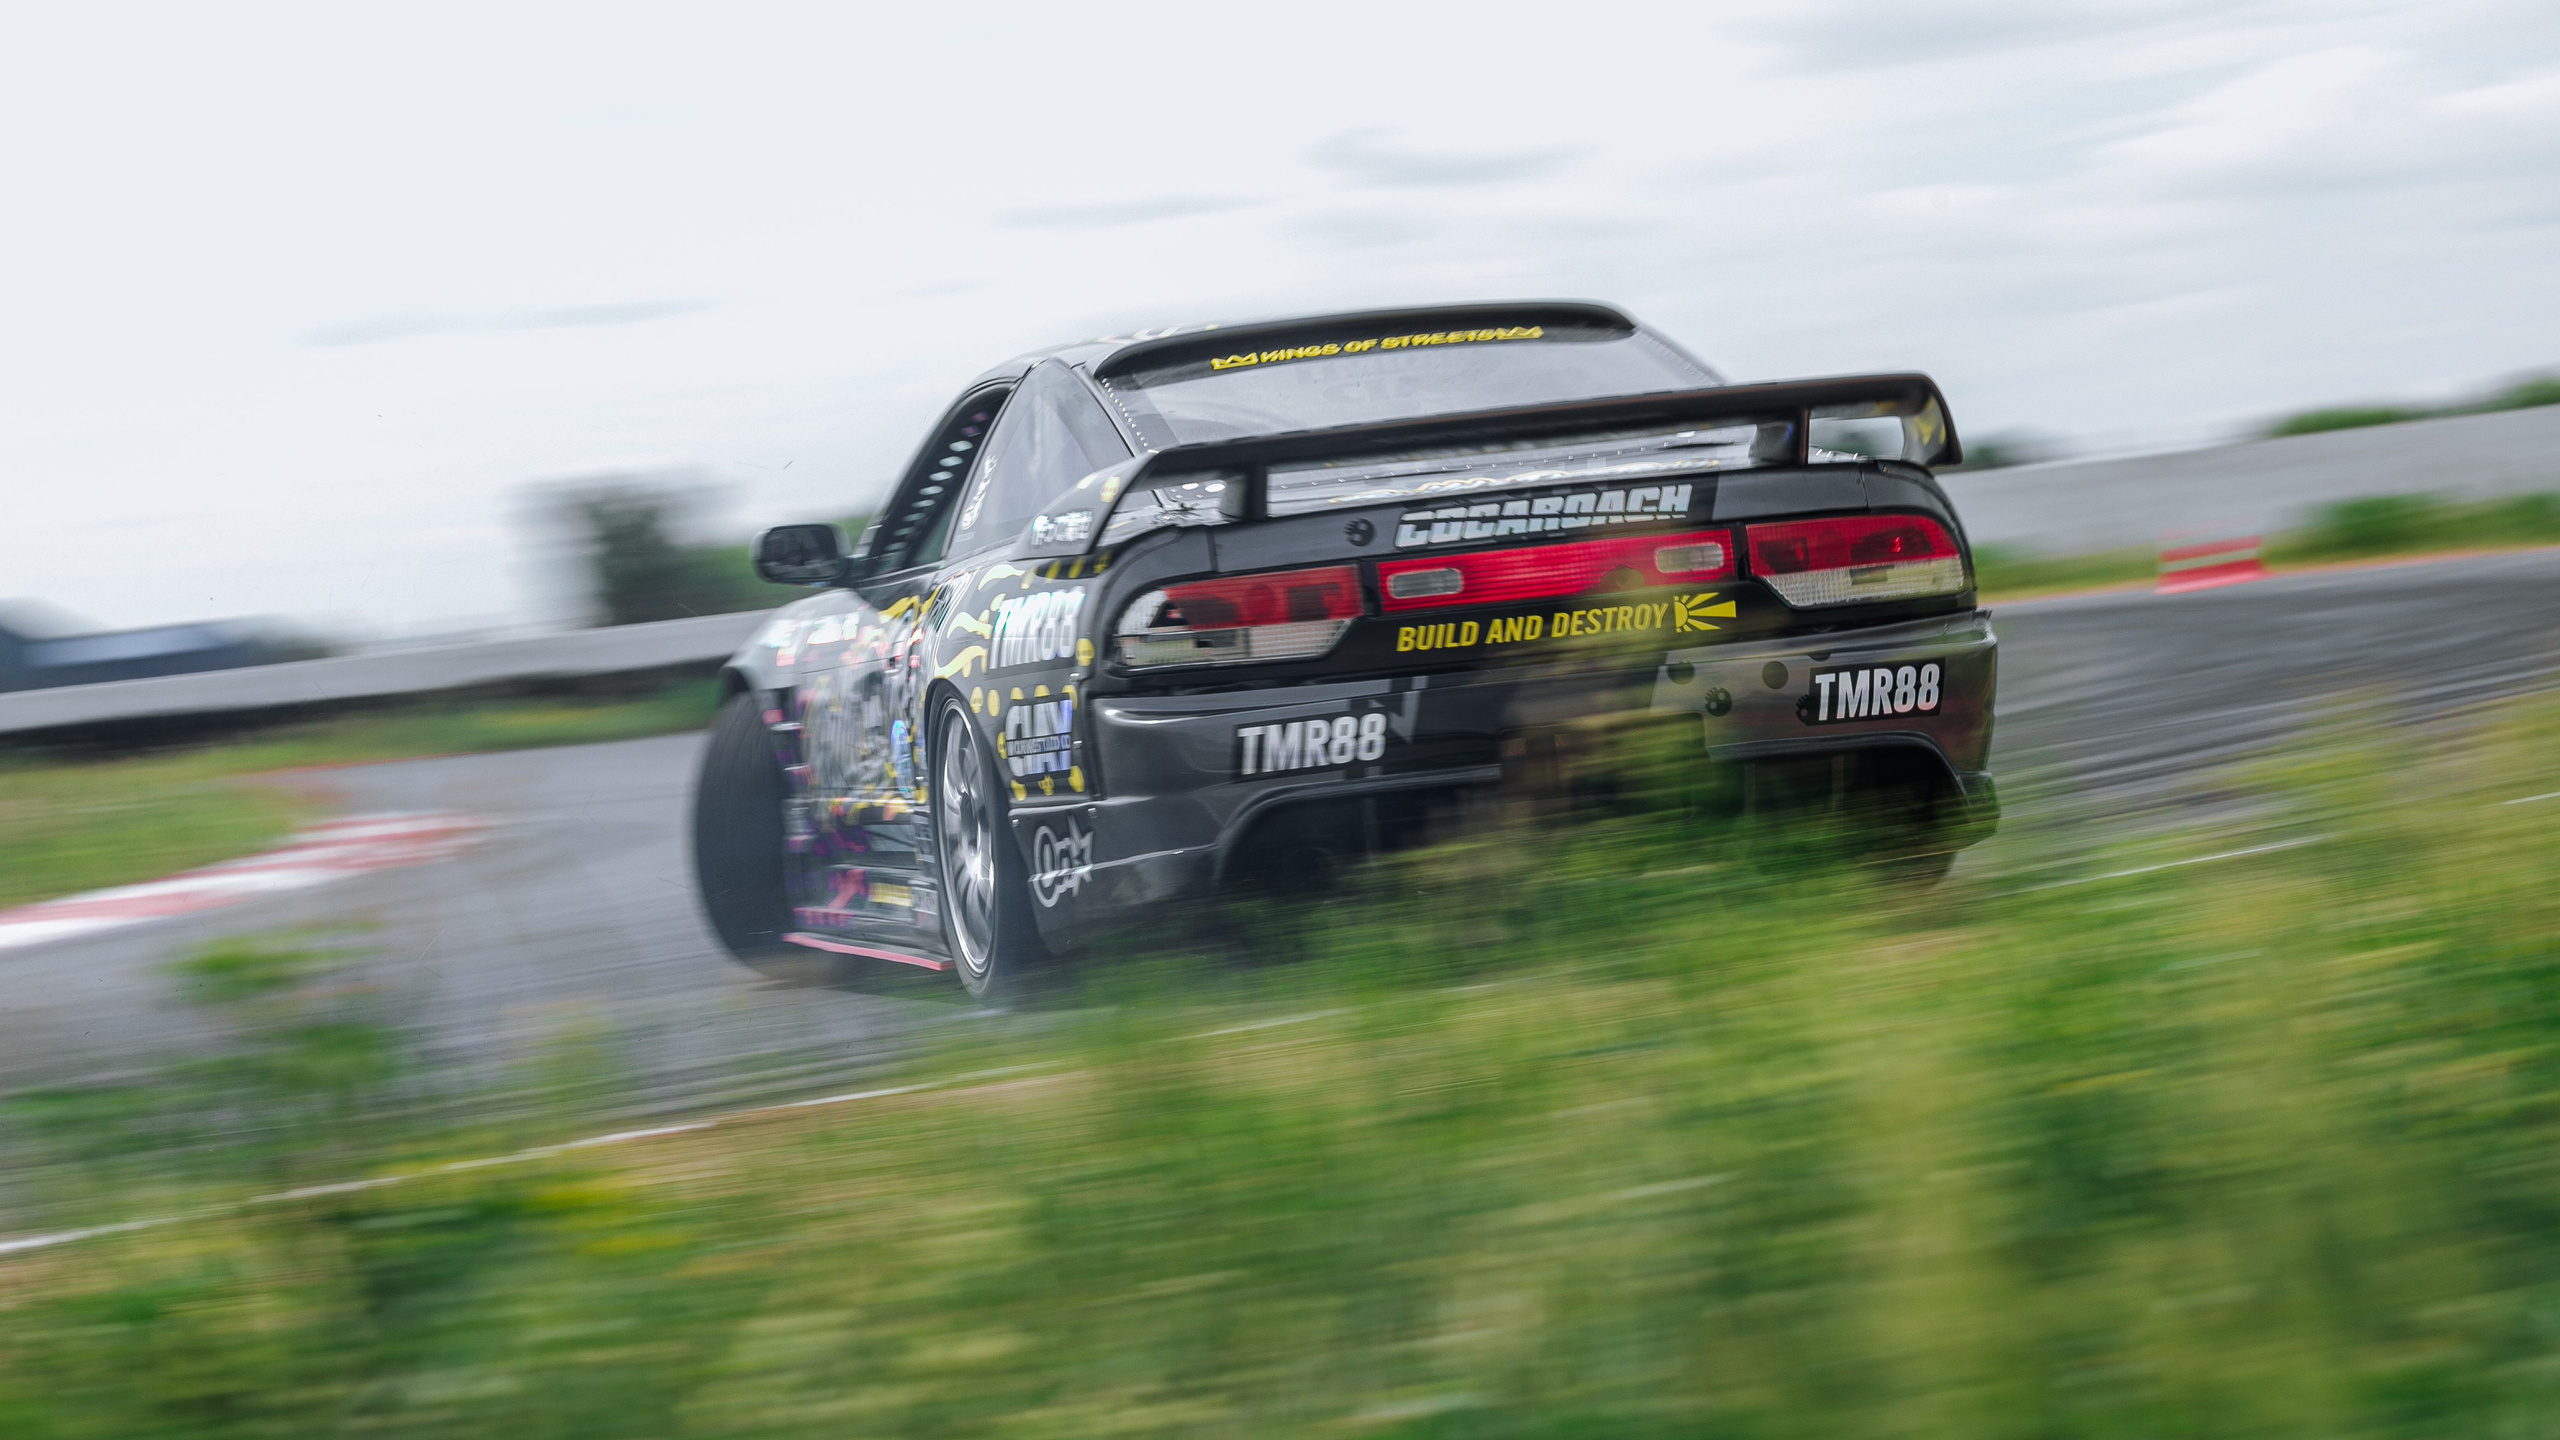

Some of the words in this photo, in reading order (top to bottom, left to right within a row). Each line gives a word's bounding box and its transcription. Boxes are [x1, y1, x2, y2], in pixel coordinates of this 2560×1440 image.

[1343, 338, 1378, 353] OF
[989, 585, 1085, 669] TMR88
[1397, 620, 1480, 652] BUILD
[1485, 615, 1544, 645] AND
[1551, 603, 1669, 639] DESTROY
[1814, 663, 1940, 721] TMR88
[1237, 713, 1387, 775] TMR88
